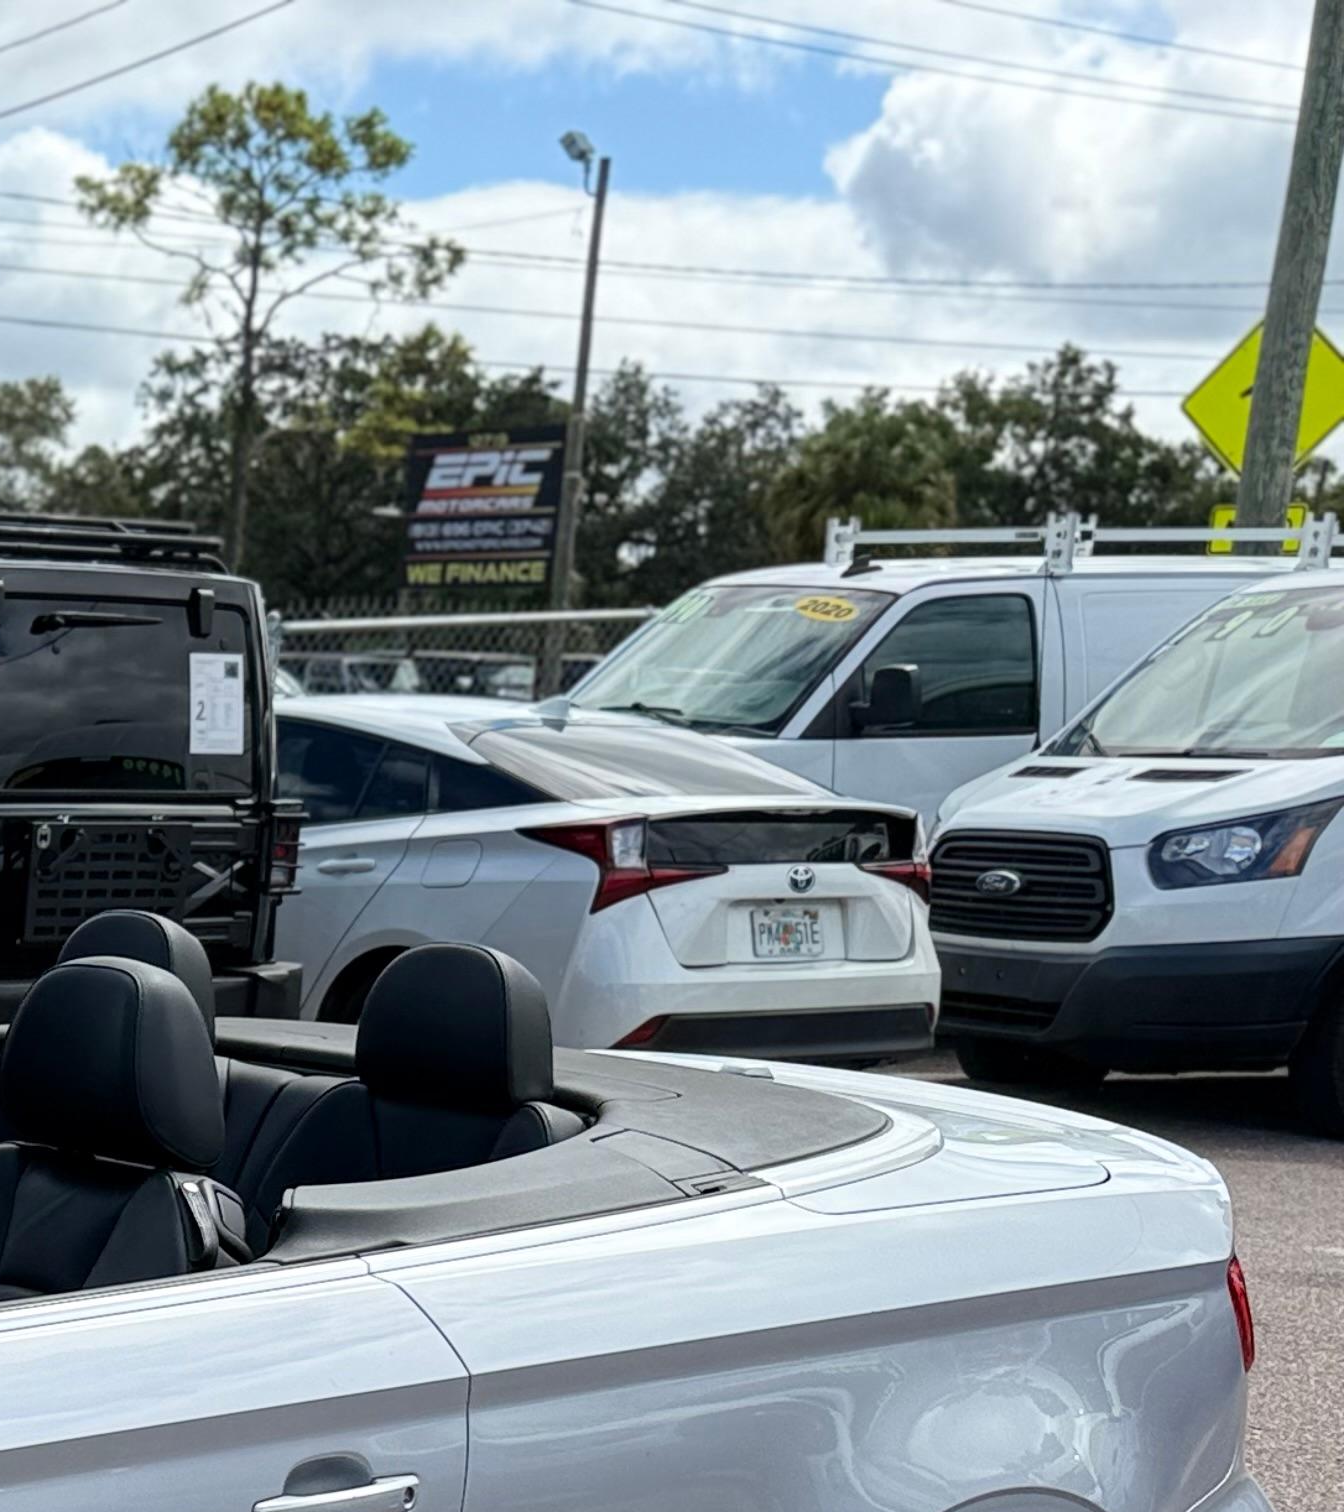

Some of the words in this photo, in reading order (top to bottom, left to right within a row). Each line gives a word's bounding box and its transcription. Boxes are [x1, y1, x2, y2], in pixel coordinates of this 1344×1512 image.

[407, 562, 443, 584] WE
[445, 560, 546, 583] FINANCE
[799, 600, 854, 618] 2020
[195, 700, 206, 720] 2
